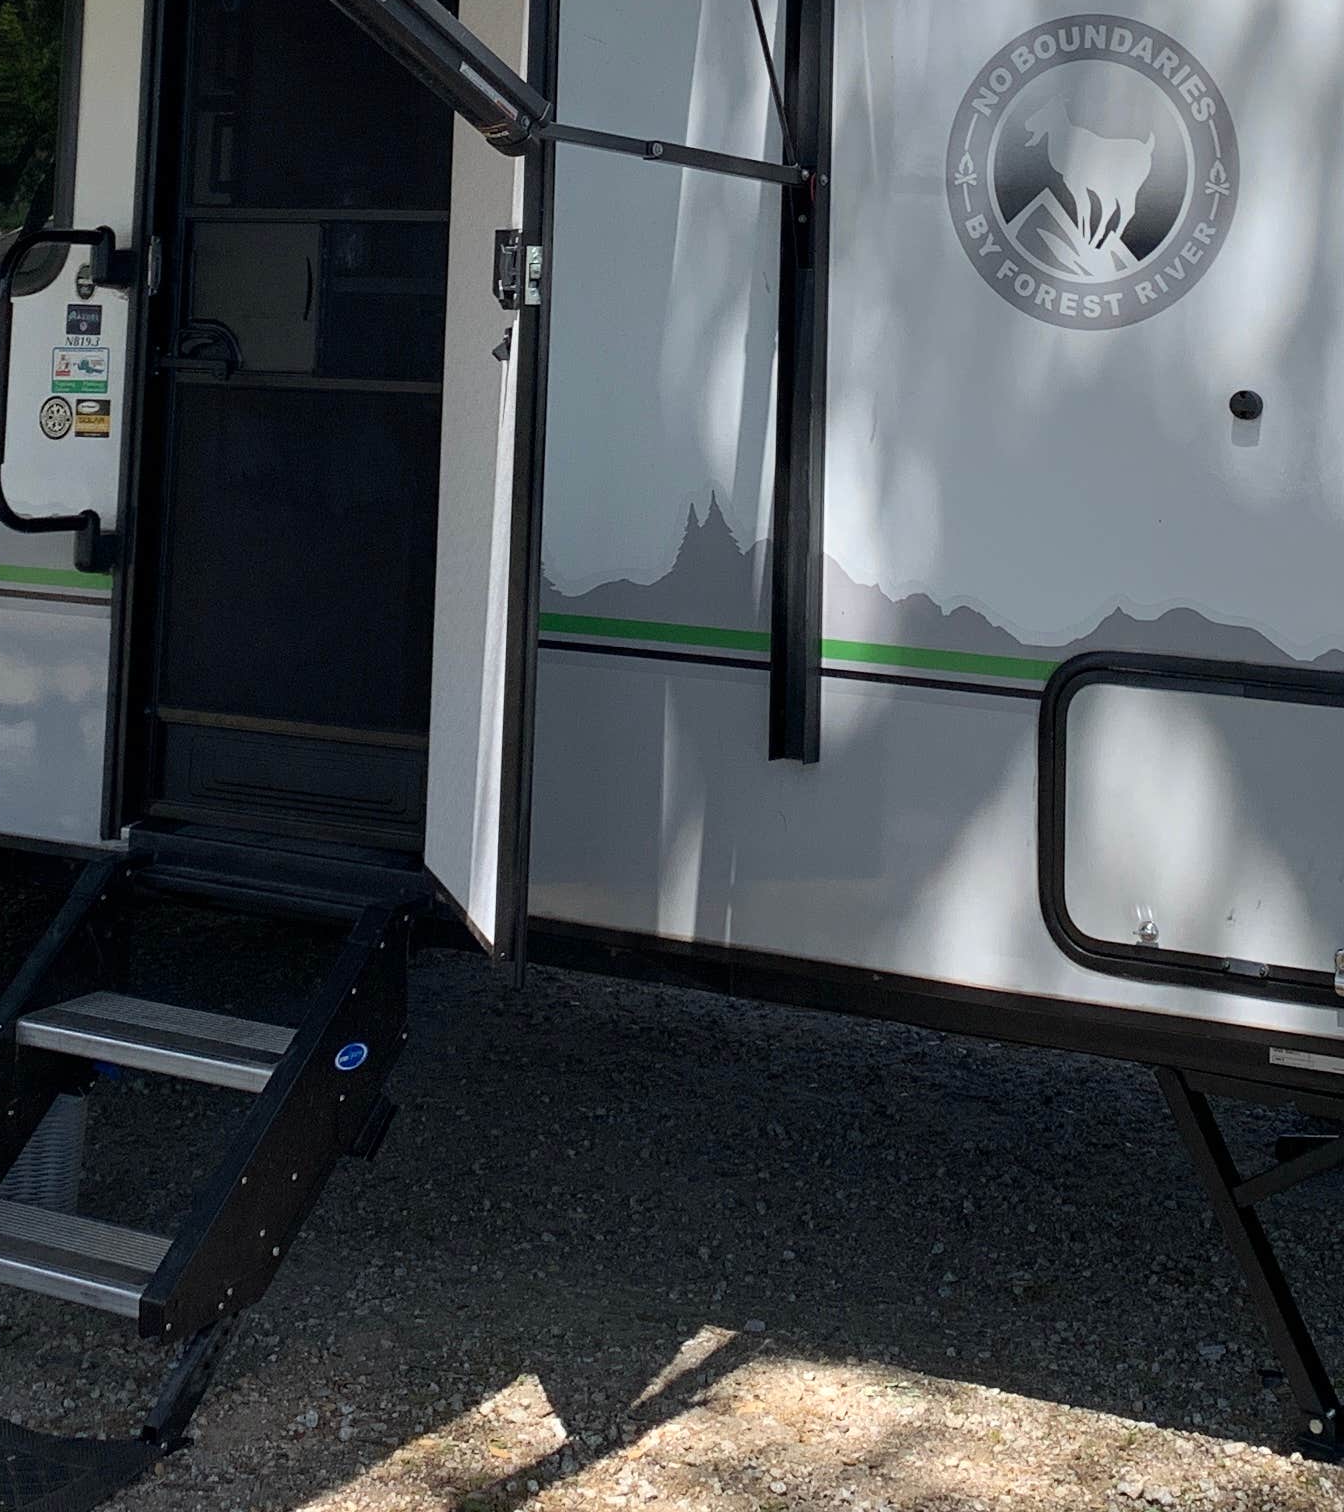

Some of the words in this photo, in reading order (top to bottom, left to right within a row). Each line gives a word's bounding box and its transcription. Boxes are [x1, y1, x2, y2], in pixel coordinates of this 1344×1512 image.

[971, 69, 1014, 118] NO
[1010, 24, 1216, 124] BOUNDARIES
[964, 213, 1003, 258] BY
[995, 262, 1124, 319] FOREST
[1134, 224, 1217, 305] RIVER
[65, 336, 101, 347] NB19.3
